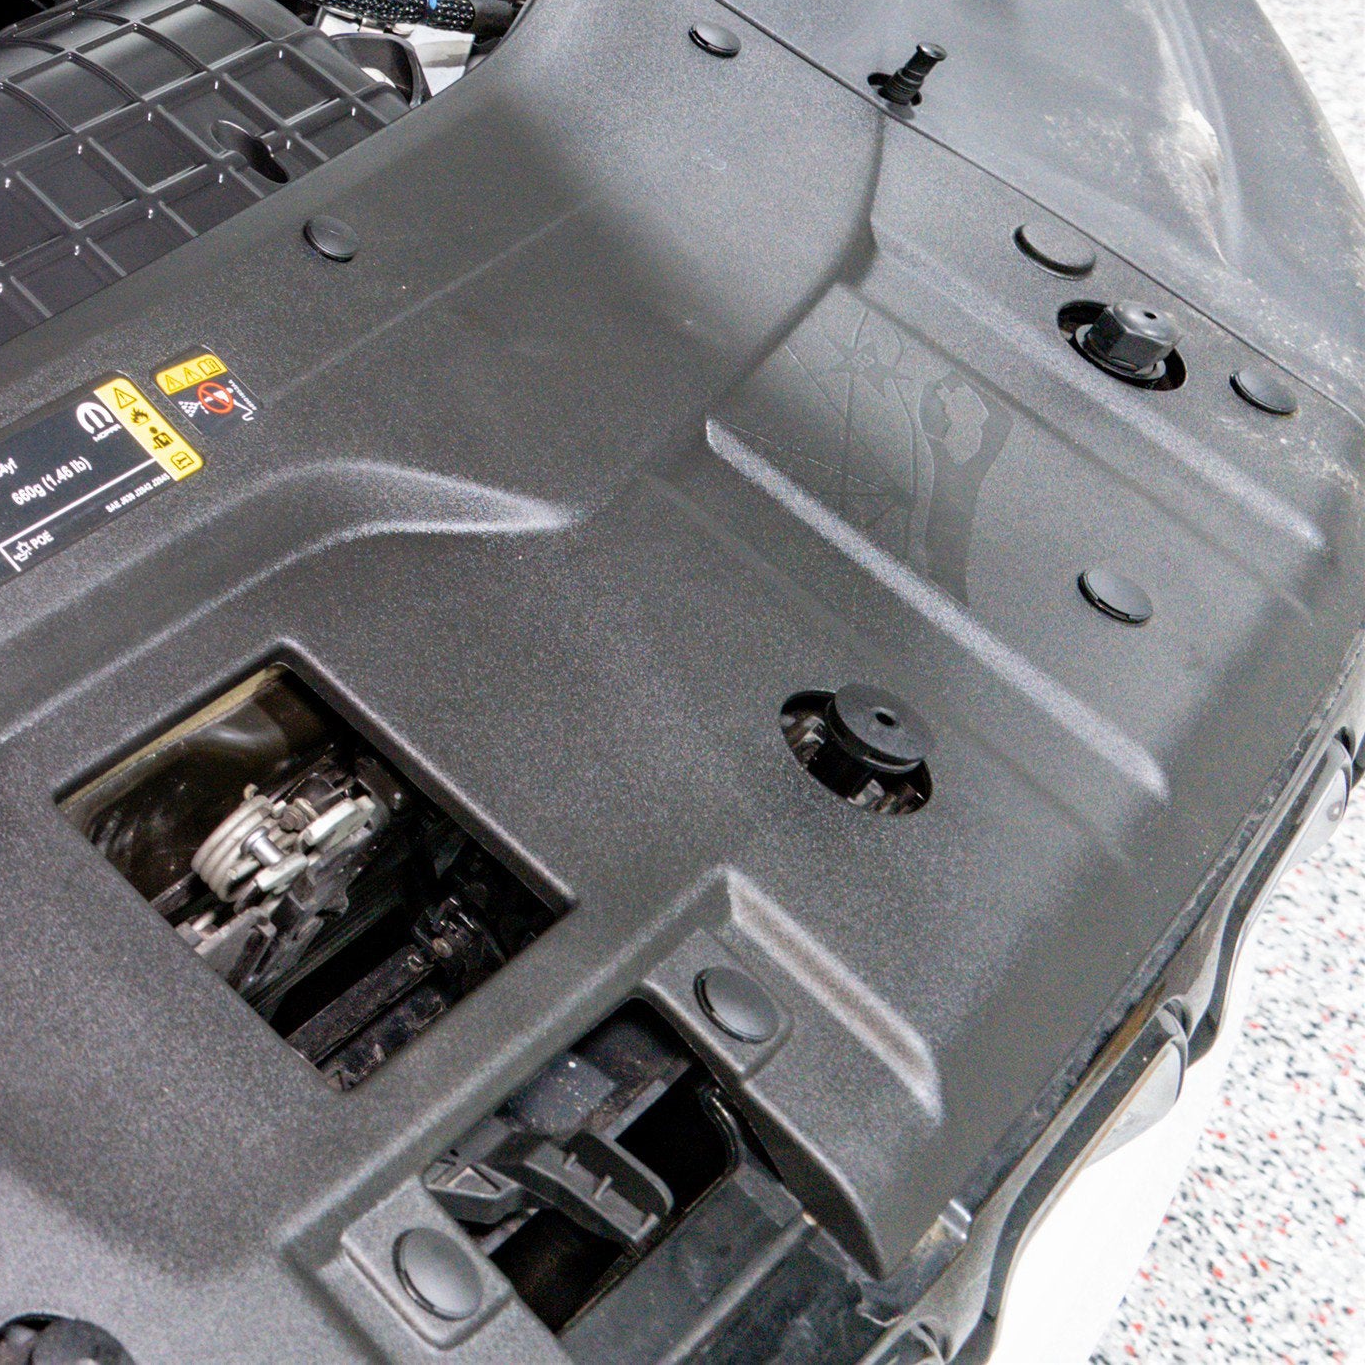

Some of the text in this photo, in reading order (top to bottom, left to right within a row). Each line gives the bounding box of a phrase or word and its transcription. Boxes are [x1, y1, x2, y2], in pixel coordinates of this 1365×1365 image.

[11, 456, 92, 506] 660g (1.46 lb)
[30, 531, 54, 550] POE
